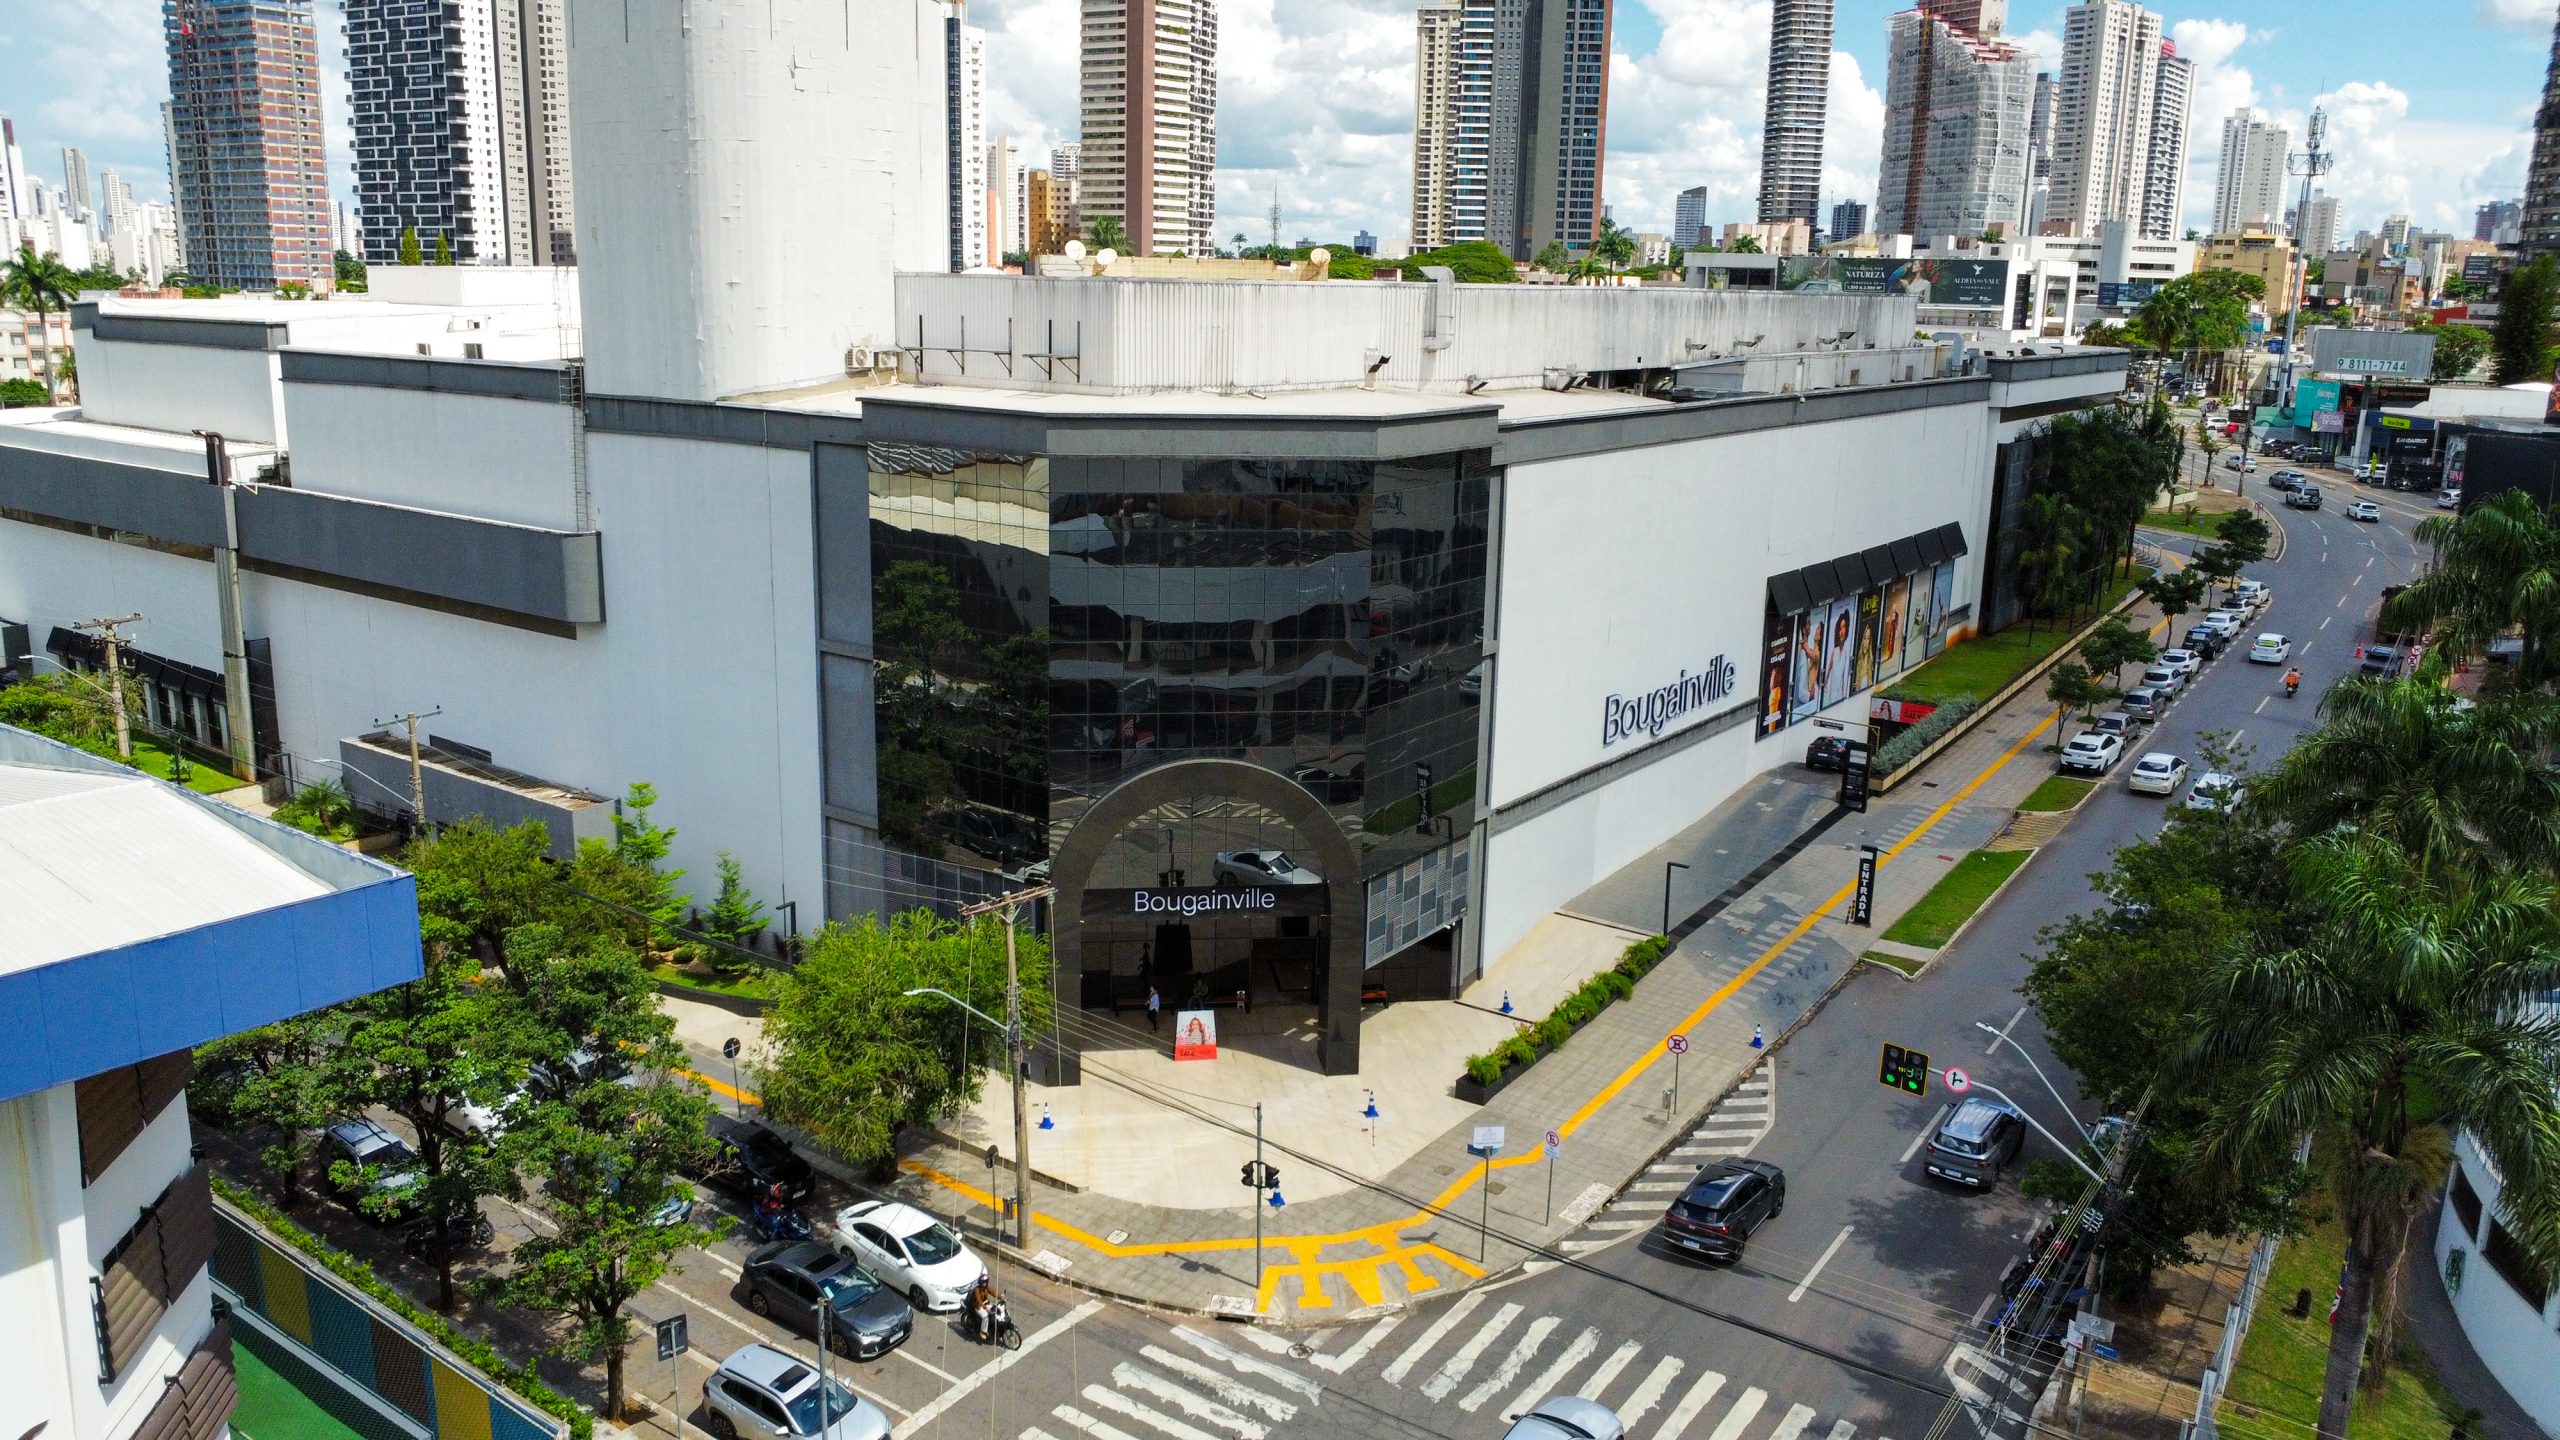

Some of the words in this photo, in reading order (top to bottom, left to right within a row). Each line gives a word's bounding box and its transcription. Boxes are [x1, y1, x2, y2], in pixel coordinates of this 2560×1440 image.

[1846, 271, 1886, 279] NATUREZA
[2338, 358, 2344, 369] 9
[2348, 359, 2406, 372] 8111-7744
[1603, 654, 1736, 745] Bougainville
[1134, 888, 1276, 916] Bougainville
[1858, 863, 1870, 918] ENTRADA
